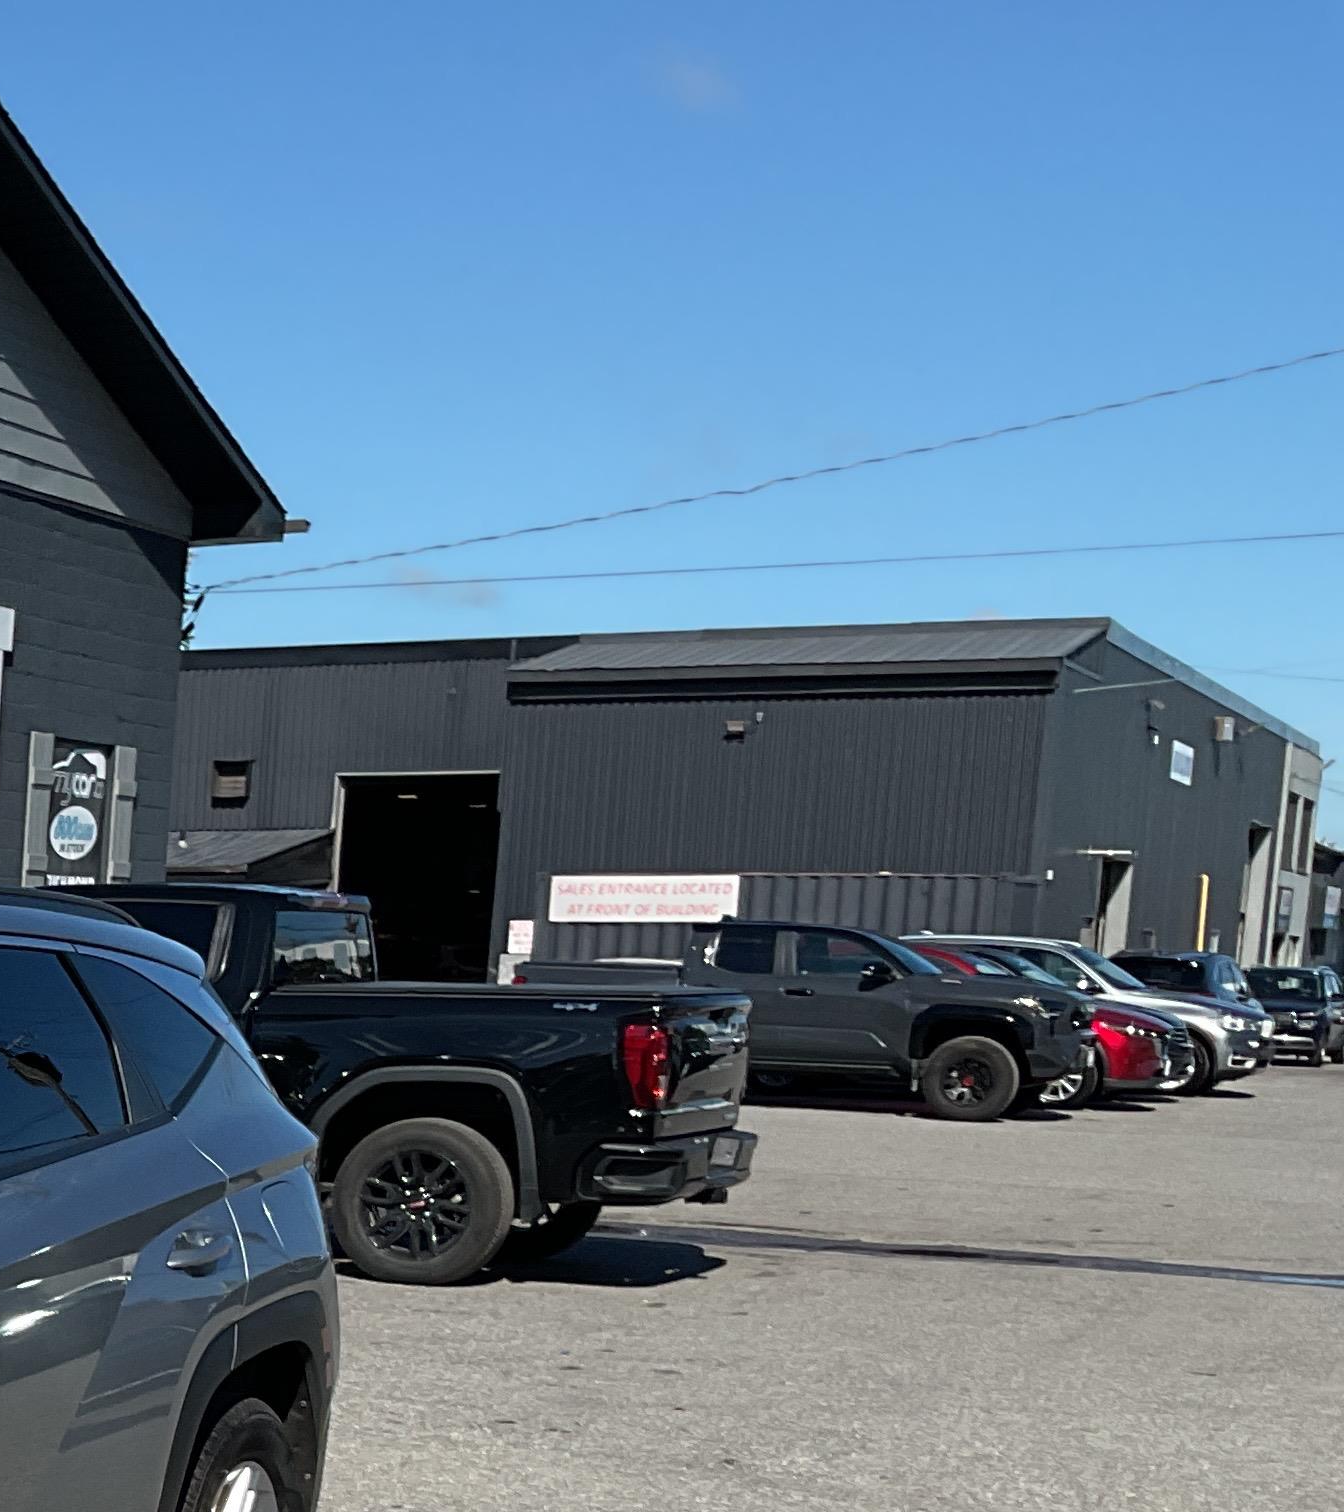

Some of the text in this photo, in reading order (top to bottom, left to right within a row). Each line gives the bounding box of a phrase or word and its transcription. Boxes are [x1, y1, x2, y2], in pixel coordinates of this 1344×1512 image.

[558, 883, 733, 895] SALES ENTRANCE LOCATED
[586, 903, 630, 915] FRONT
[655, 903, 719, 915] BUILDING
